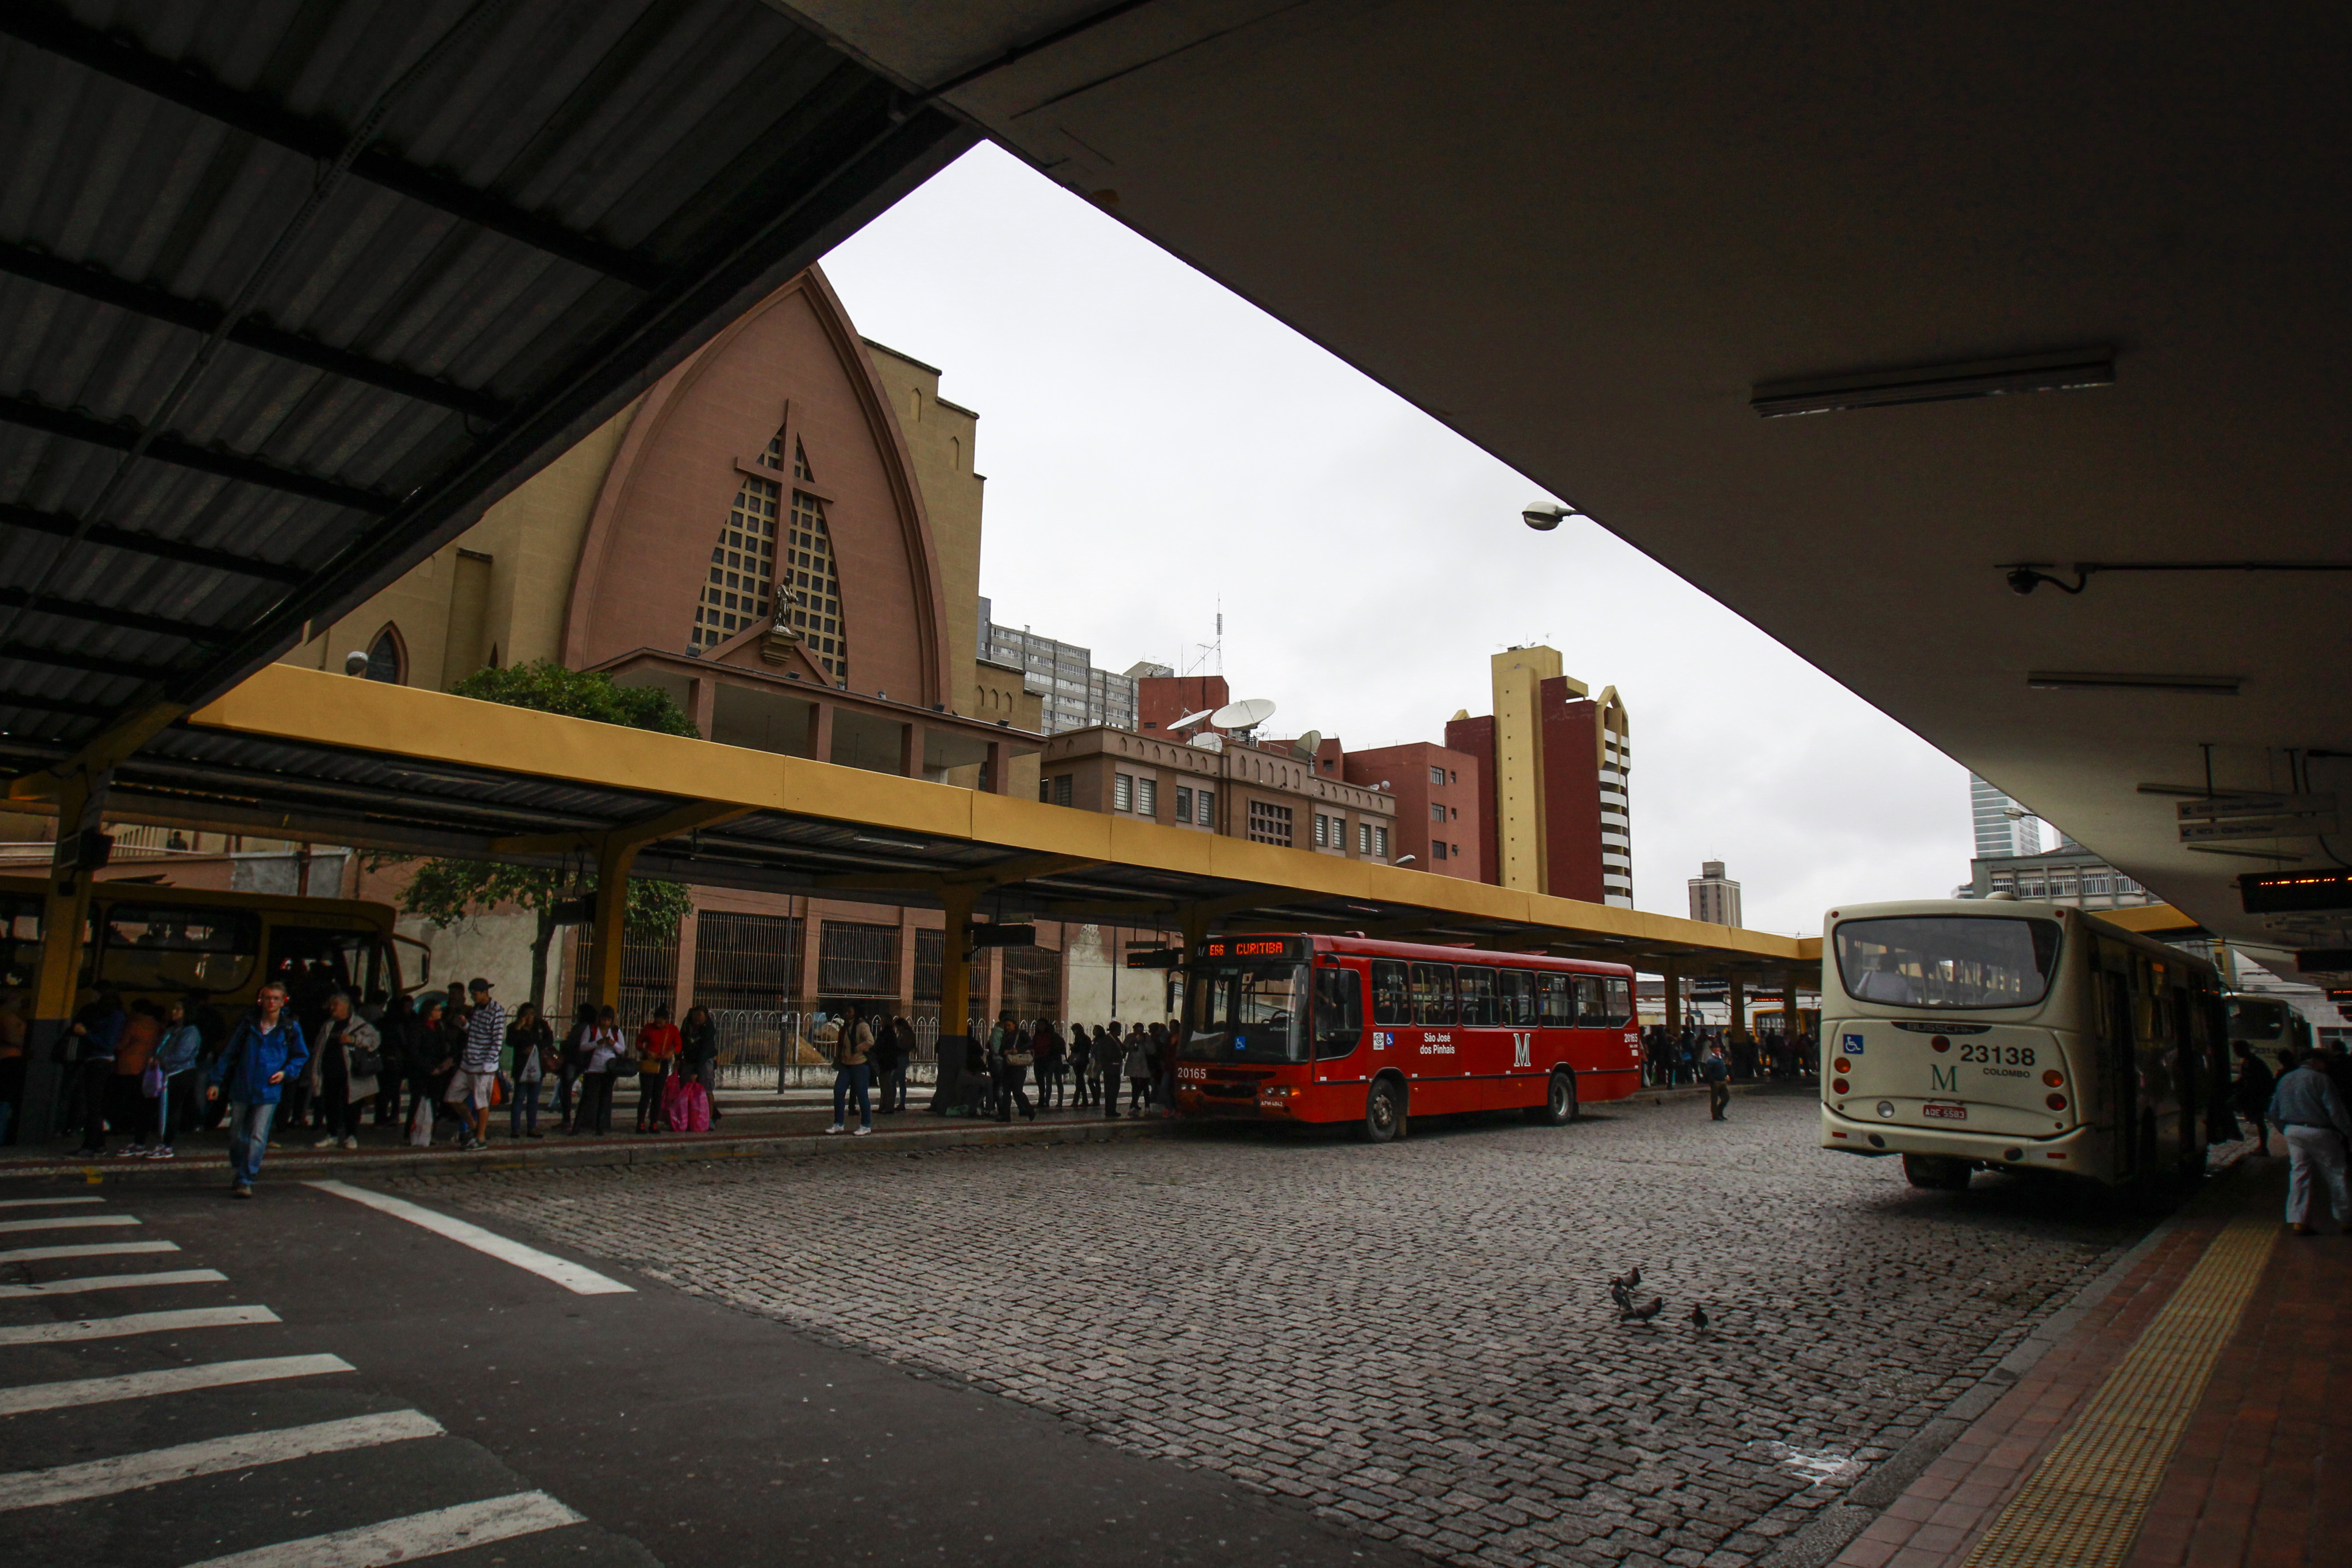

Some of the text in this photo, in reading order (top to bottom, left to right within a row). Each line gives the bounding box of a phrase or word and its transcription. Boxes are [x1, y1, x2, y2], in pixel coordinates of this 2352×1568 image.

[1209, 942, 1284, 956] E66 CURITIBA
[1424, 1032, 1451, 1042] São José
[1420, 1044, 1455, 1054] dos Pinhais
[1513, 1033, 1531, 1067] M
[1960, 1044, 2035, 1066] 23138
[1177, 1067, 1207, 1079] 20165
[1930, 1064, 1958, 1092] M
[1983, 1067, 2031, 1078] COLOMBO
